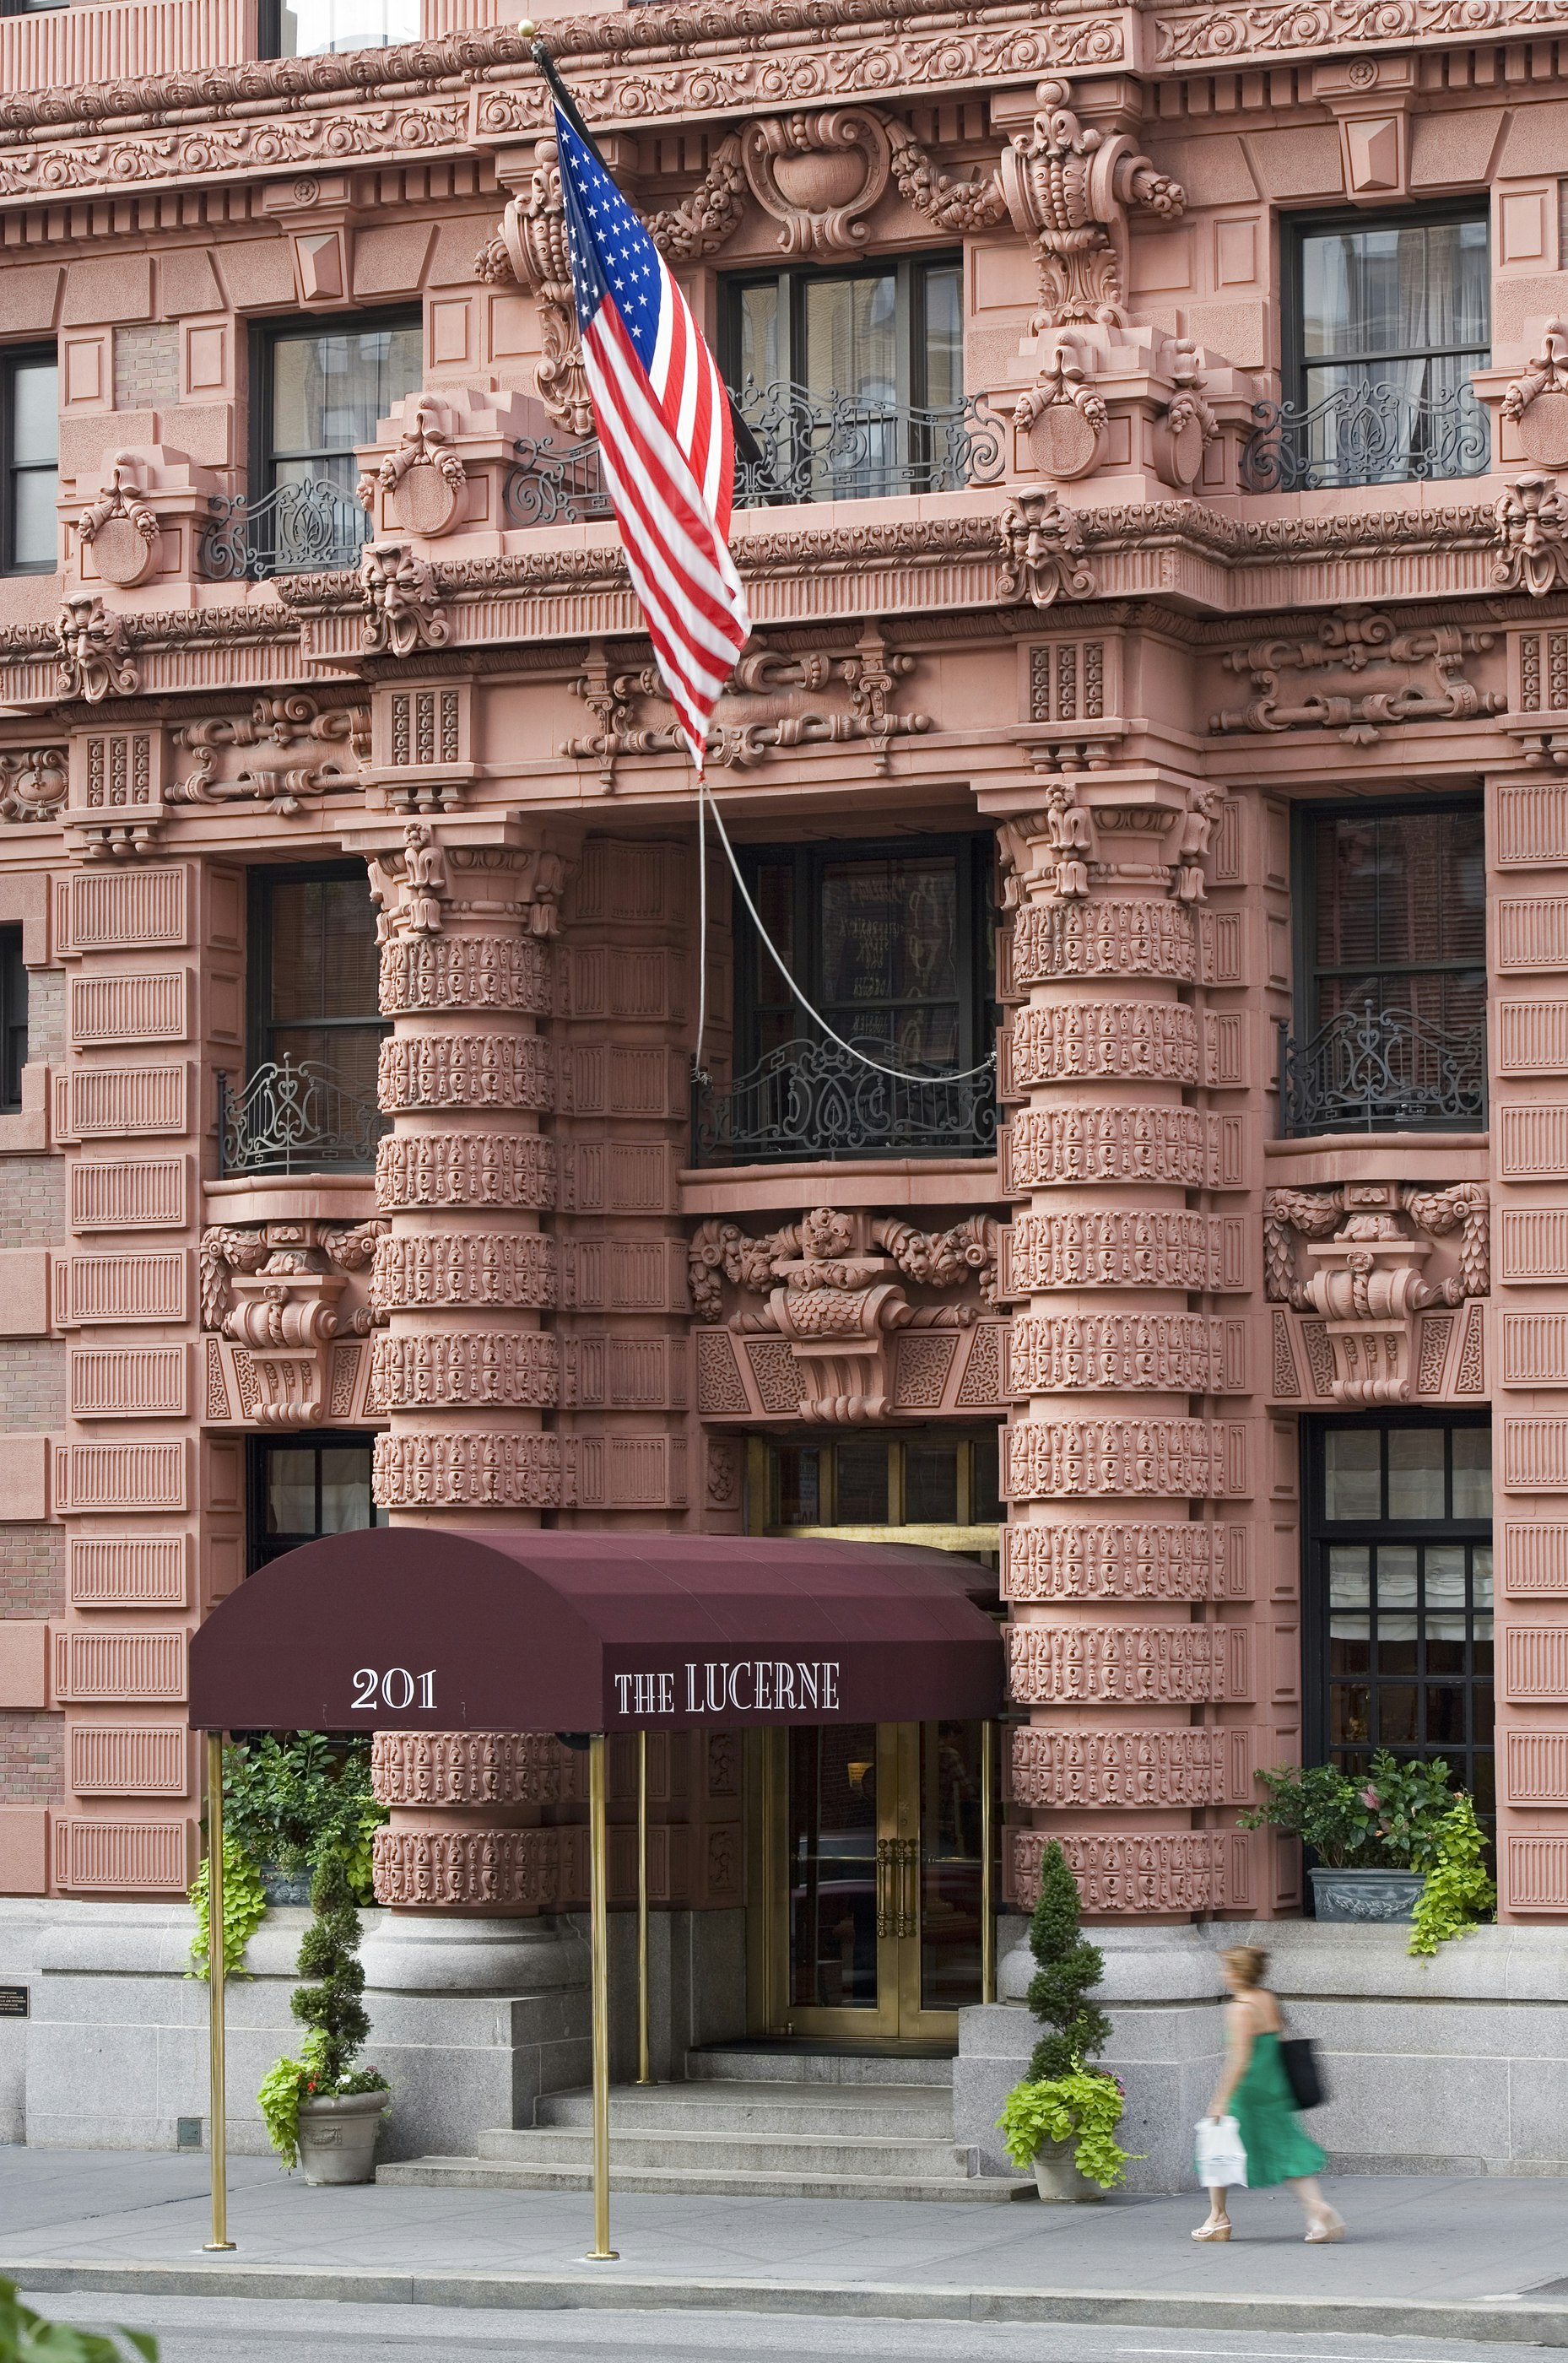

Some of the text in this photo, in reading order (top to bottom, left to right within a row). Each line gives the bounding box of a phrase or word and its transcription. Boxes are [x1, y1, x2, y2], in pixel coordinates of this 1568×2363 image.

[350, 1668, 438, 1711] 201
[614, 1661, 840, 1714] THE LUCERNE
